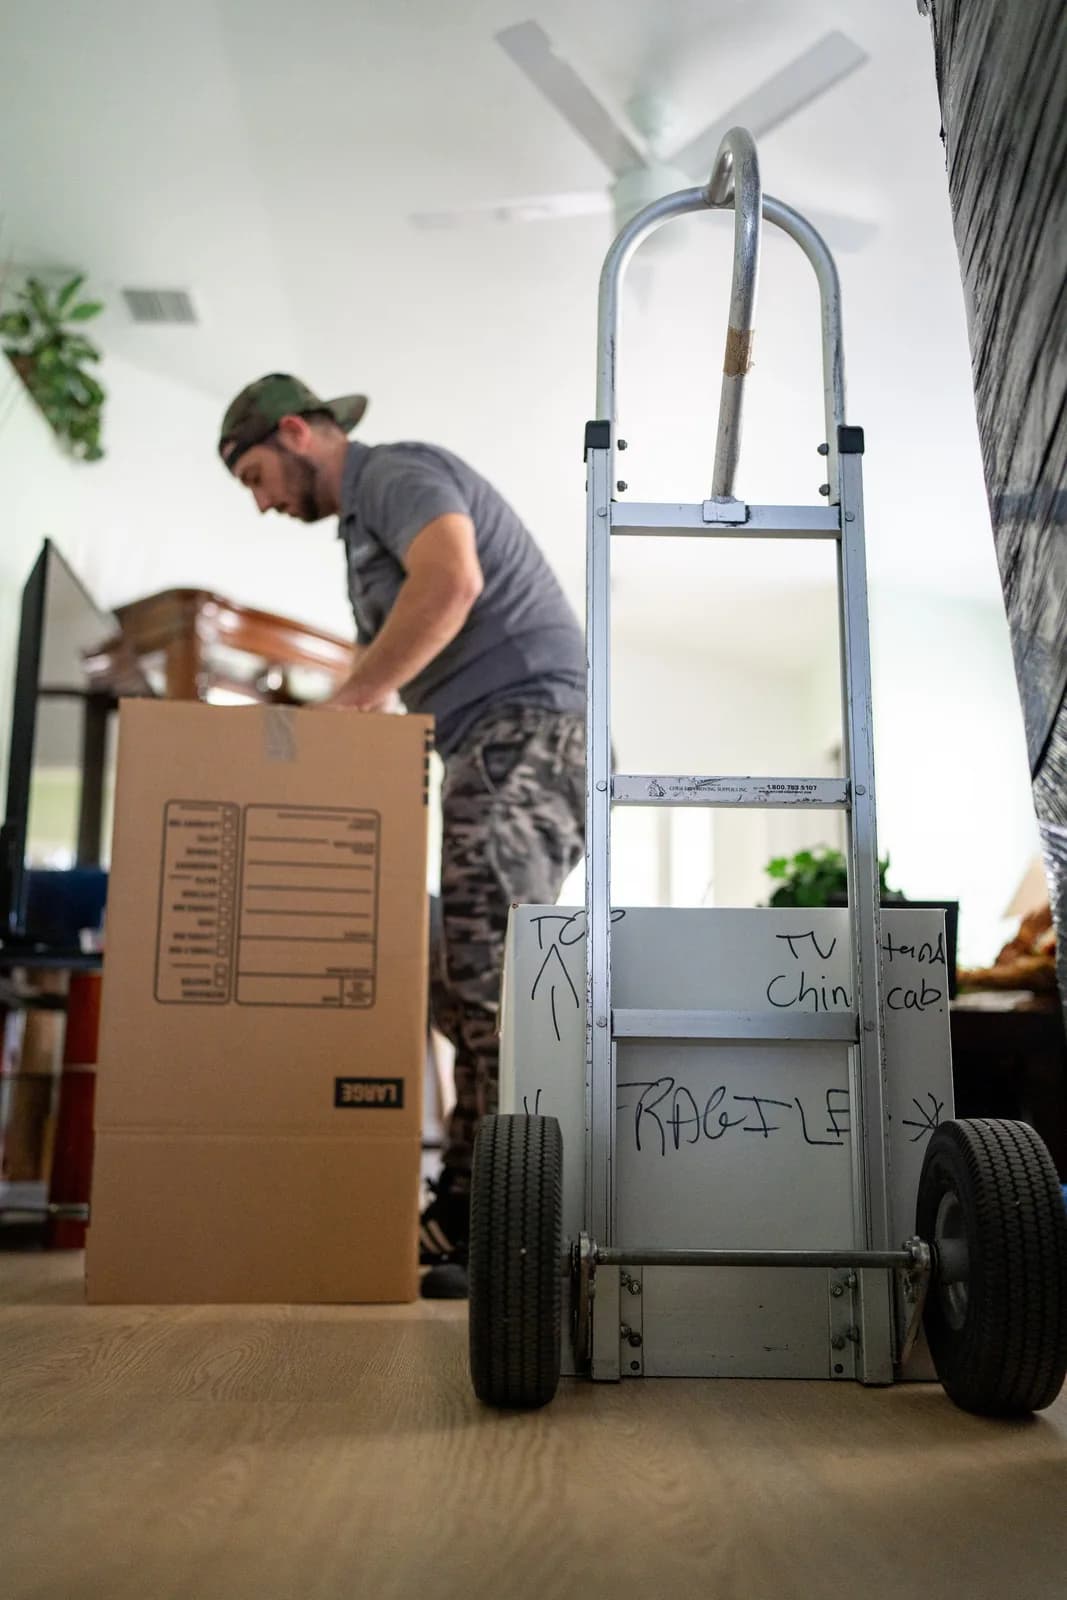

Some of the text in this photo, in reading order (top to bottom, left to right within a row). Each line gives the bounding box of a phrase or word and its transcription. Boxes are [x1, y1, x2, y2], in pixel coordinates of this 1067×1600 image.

[776, 931, 946, 965] TV tand
[766, 971, 851, 1012] Chin
[341, 1082, 397, 1104] LARGE
